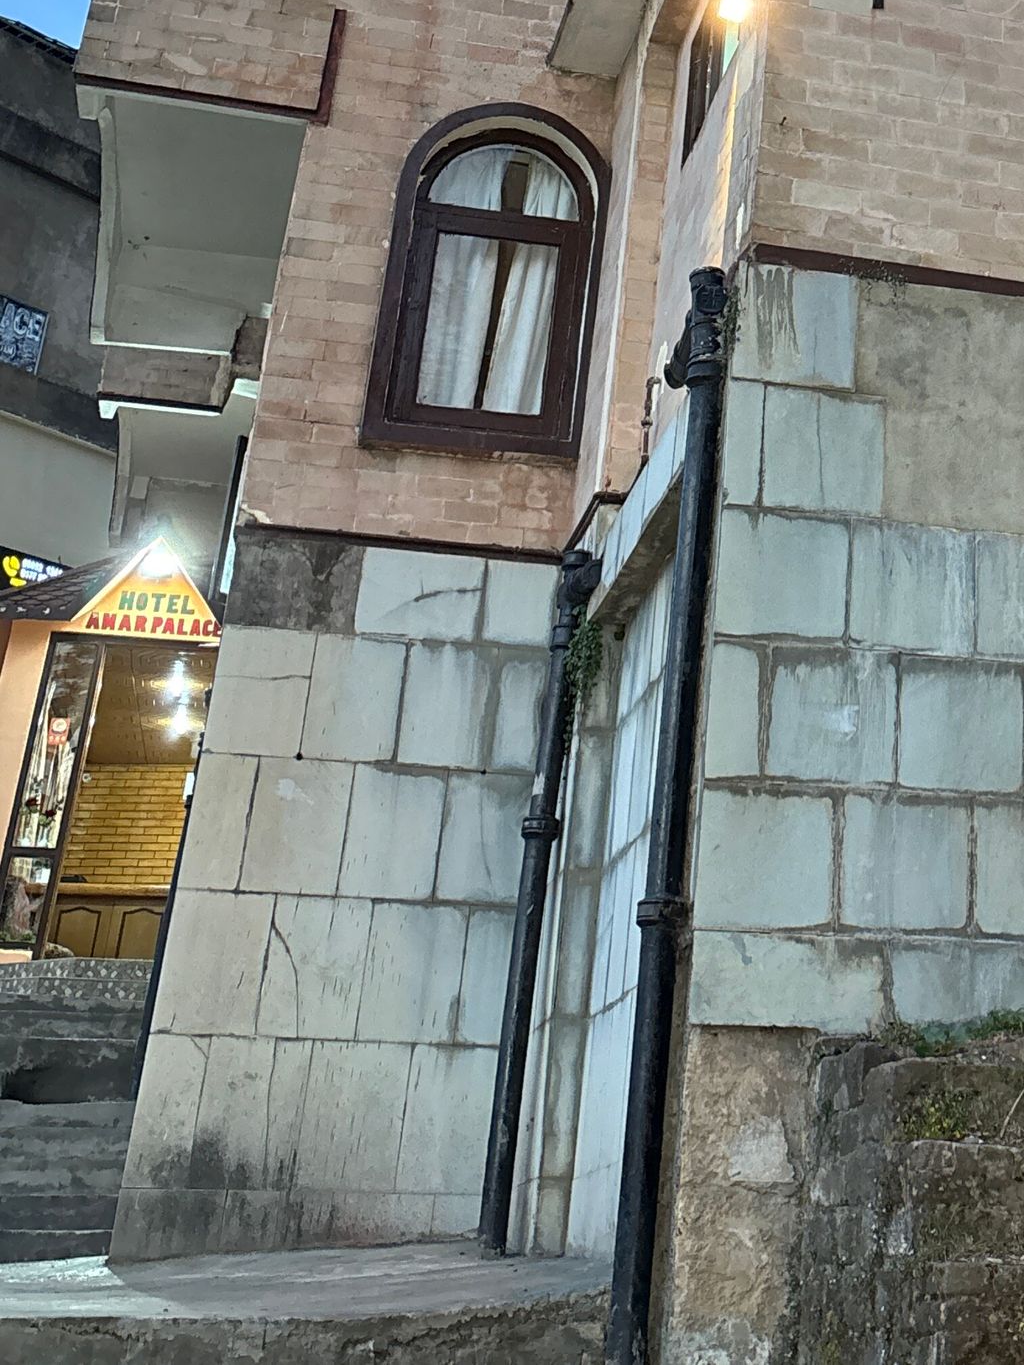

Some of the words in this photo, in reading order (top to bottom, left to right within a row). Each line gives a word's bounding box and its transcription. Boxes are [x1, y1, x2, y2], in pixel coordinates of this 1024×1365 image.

[118, 590, 195, 615] HOTEL
[85, 612, 148, 633] AMAR
[150, 616, 221, 638] PALACE
